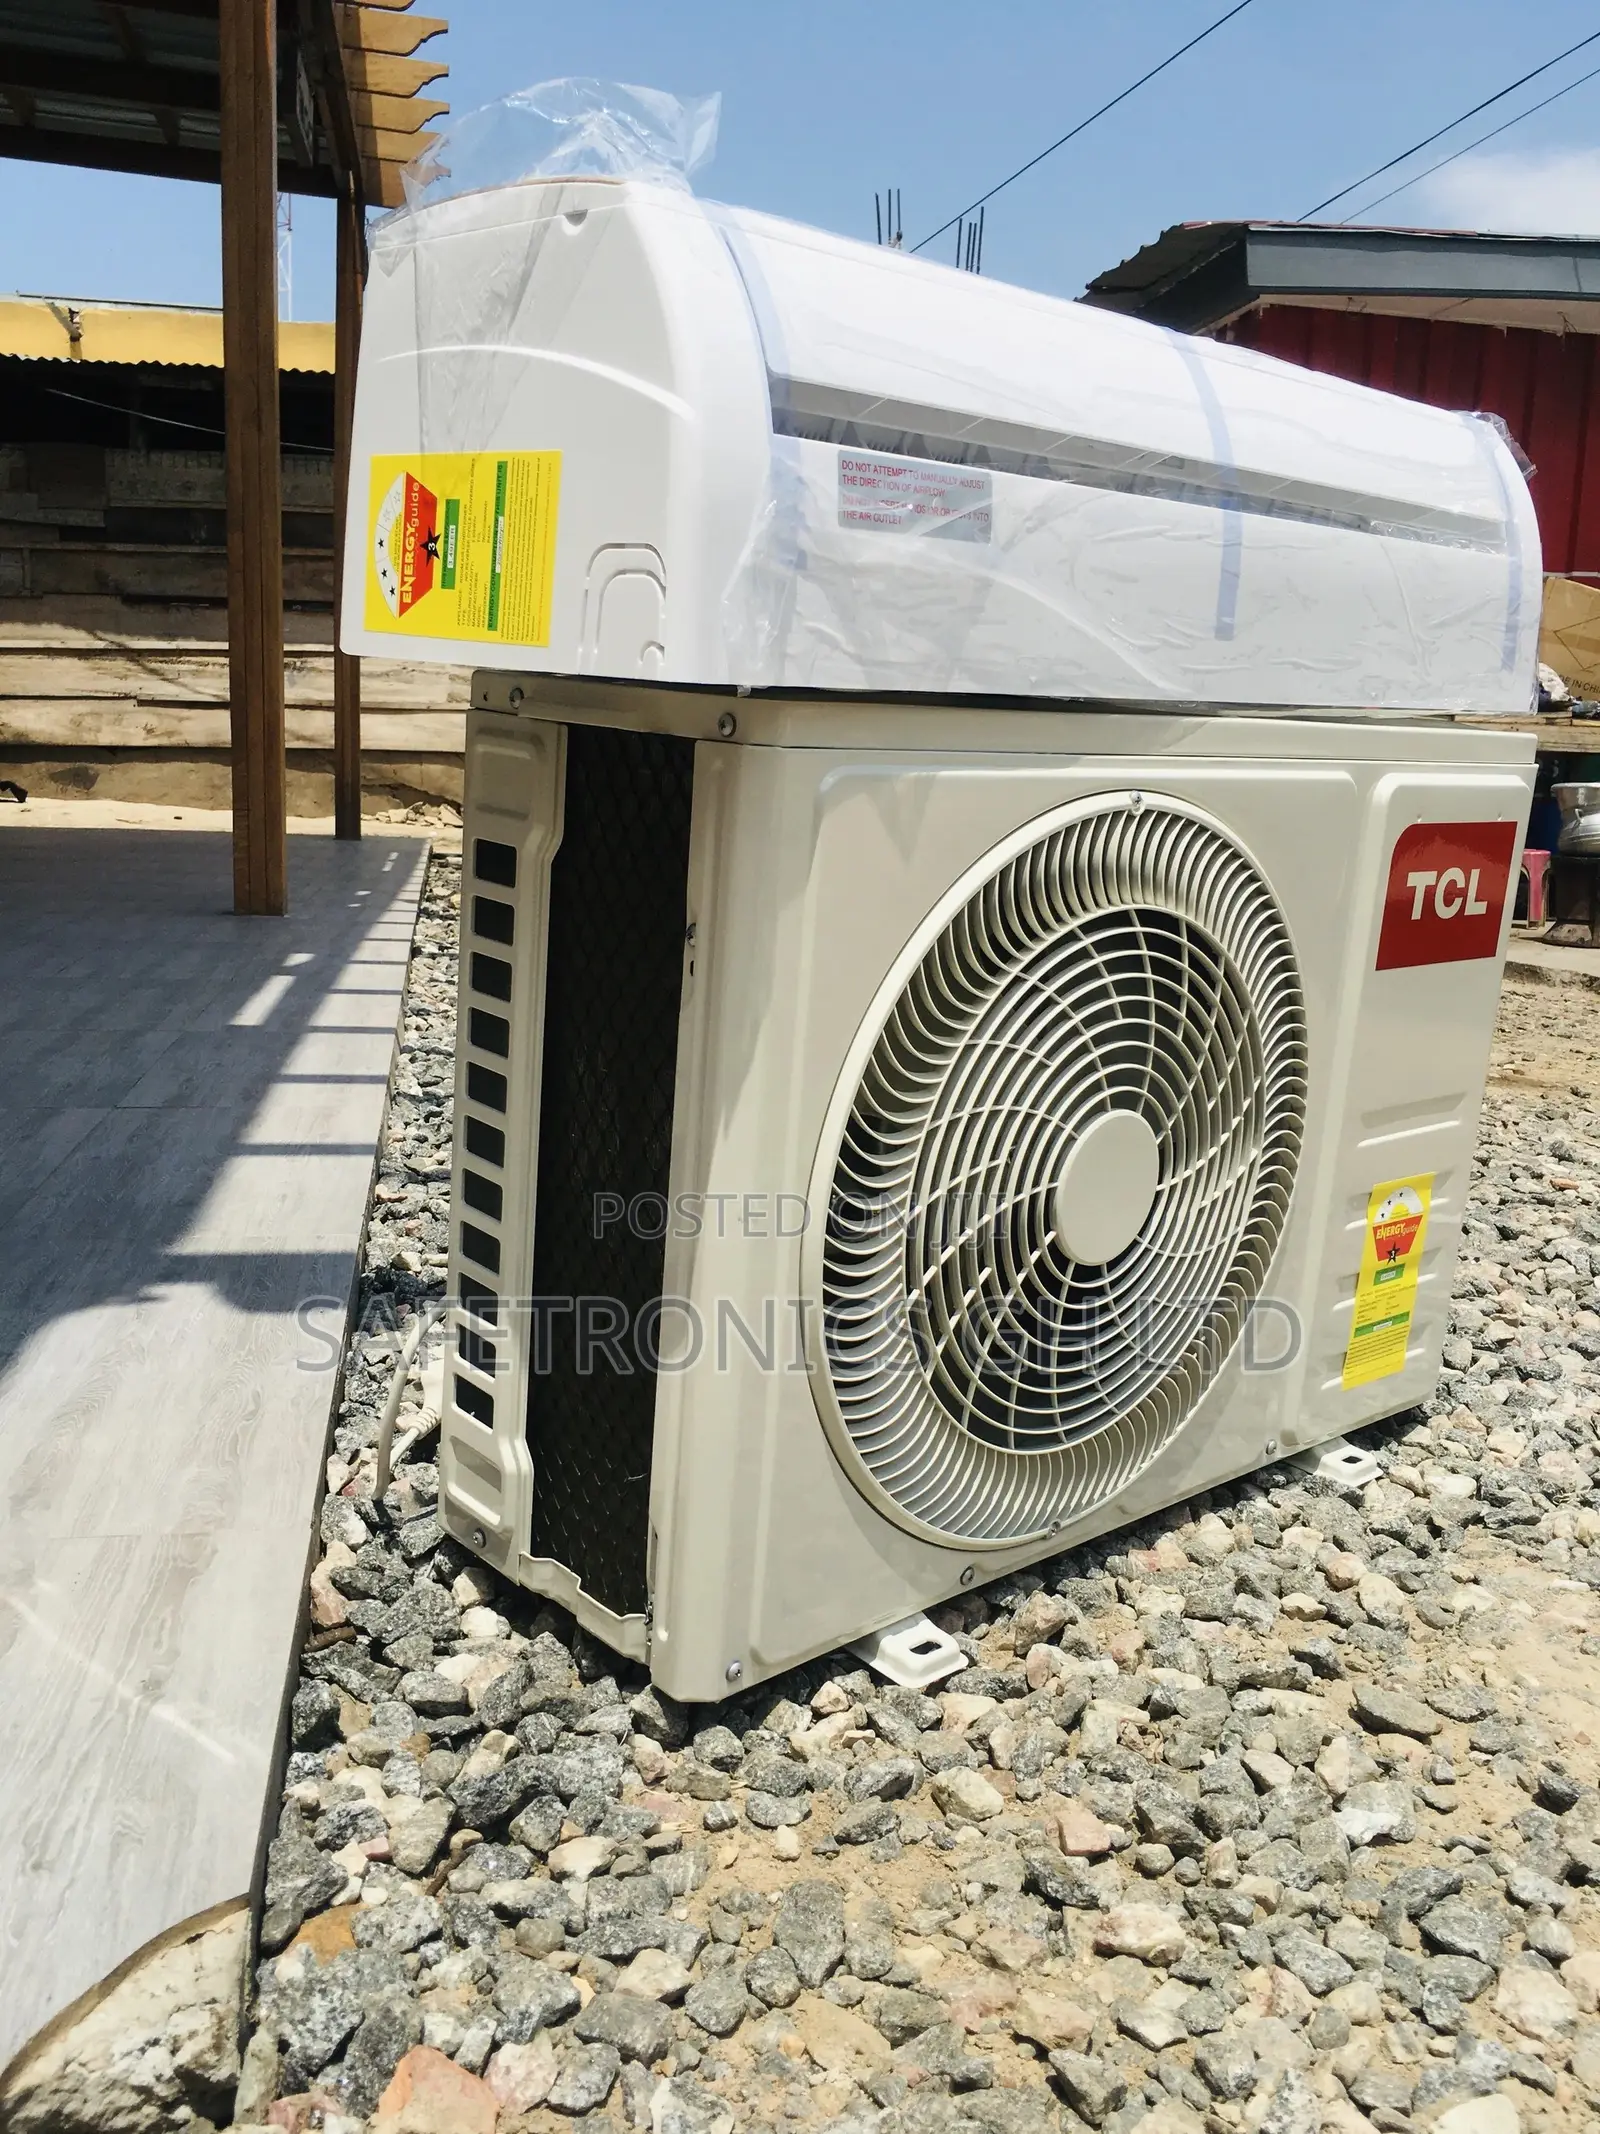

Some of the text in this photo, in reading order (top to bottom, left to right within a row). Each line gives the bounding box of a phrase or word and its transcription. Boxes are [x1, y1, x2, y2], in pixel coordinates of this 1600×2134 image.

[842, 460, 854, 470] DO
[856, 462, 872, 473] NOT
[873, 465, 908, 478] ATTEMPT
[842, 474, 857, 486] THE
[858, 512, 872, 520] AIR
[427, 542, 435, 550] 3
[1406, 867, 1488, 920] TCL
